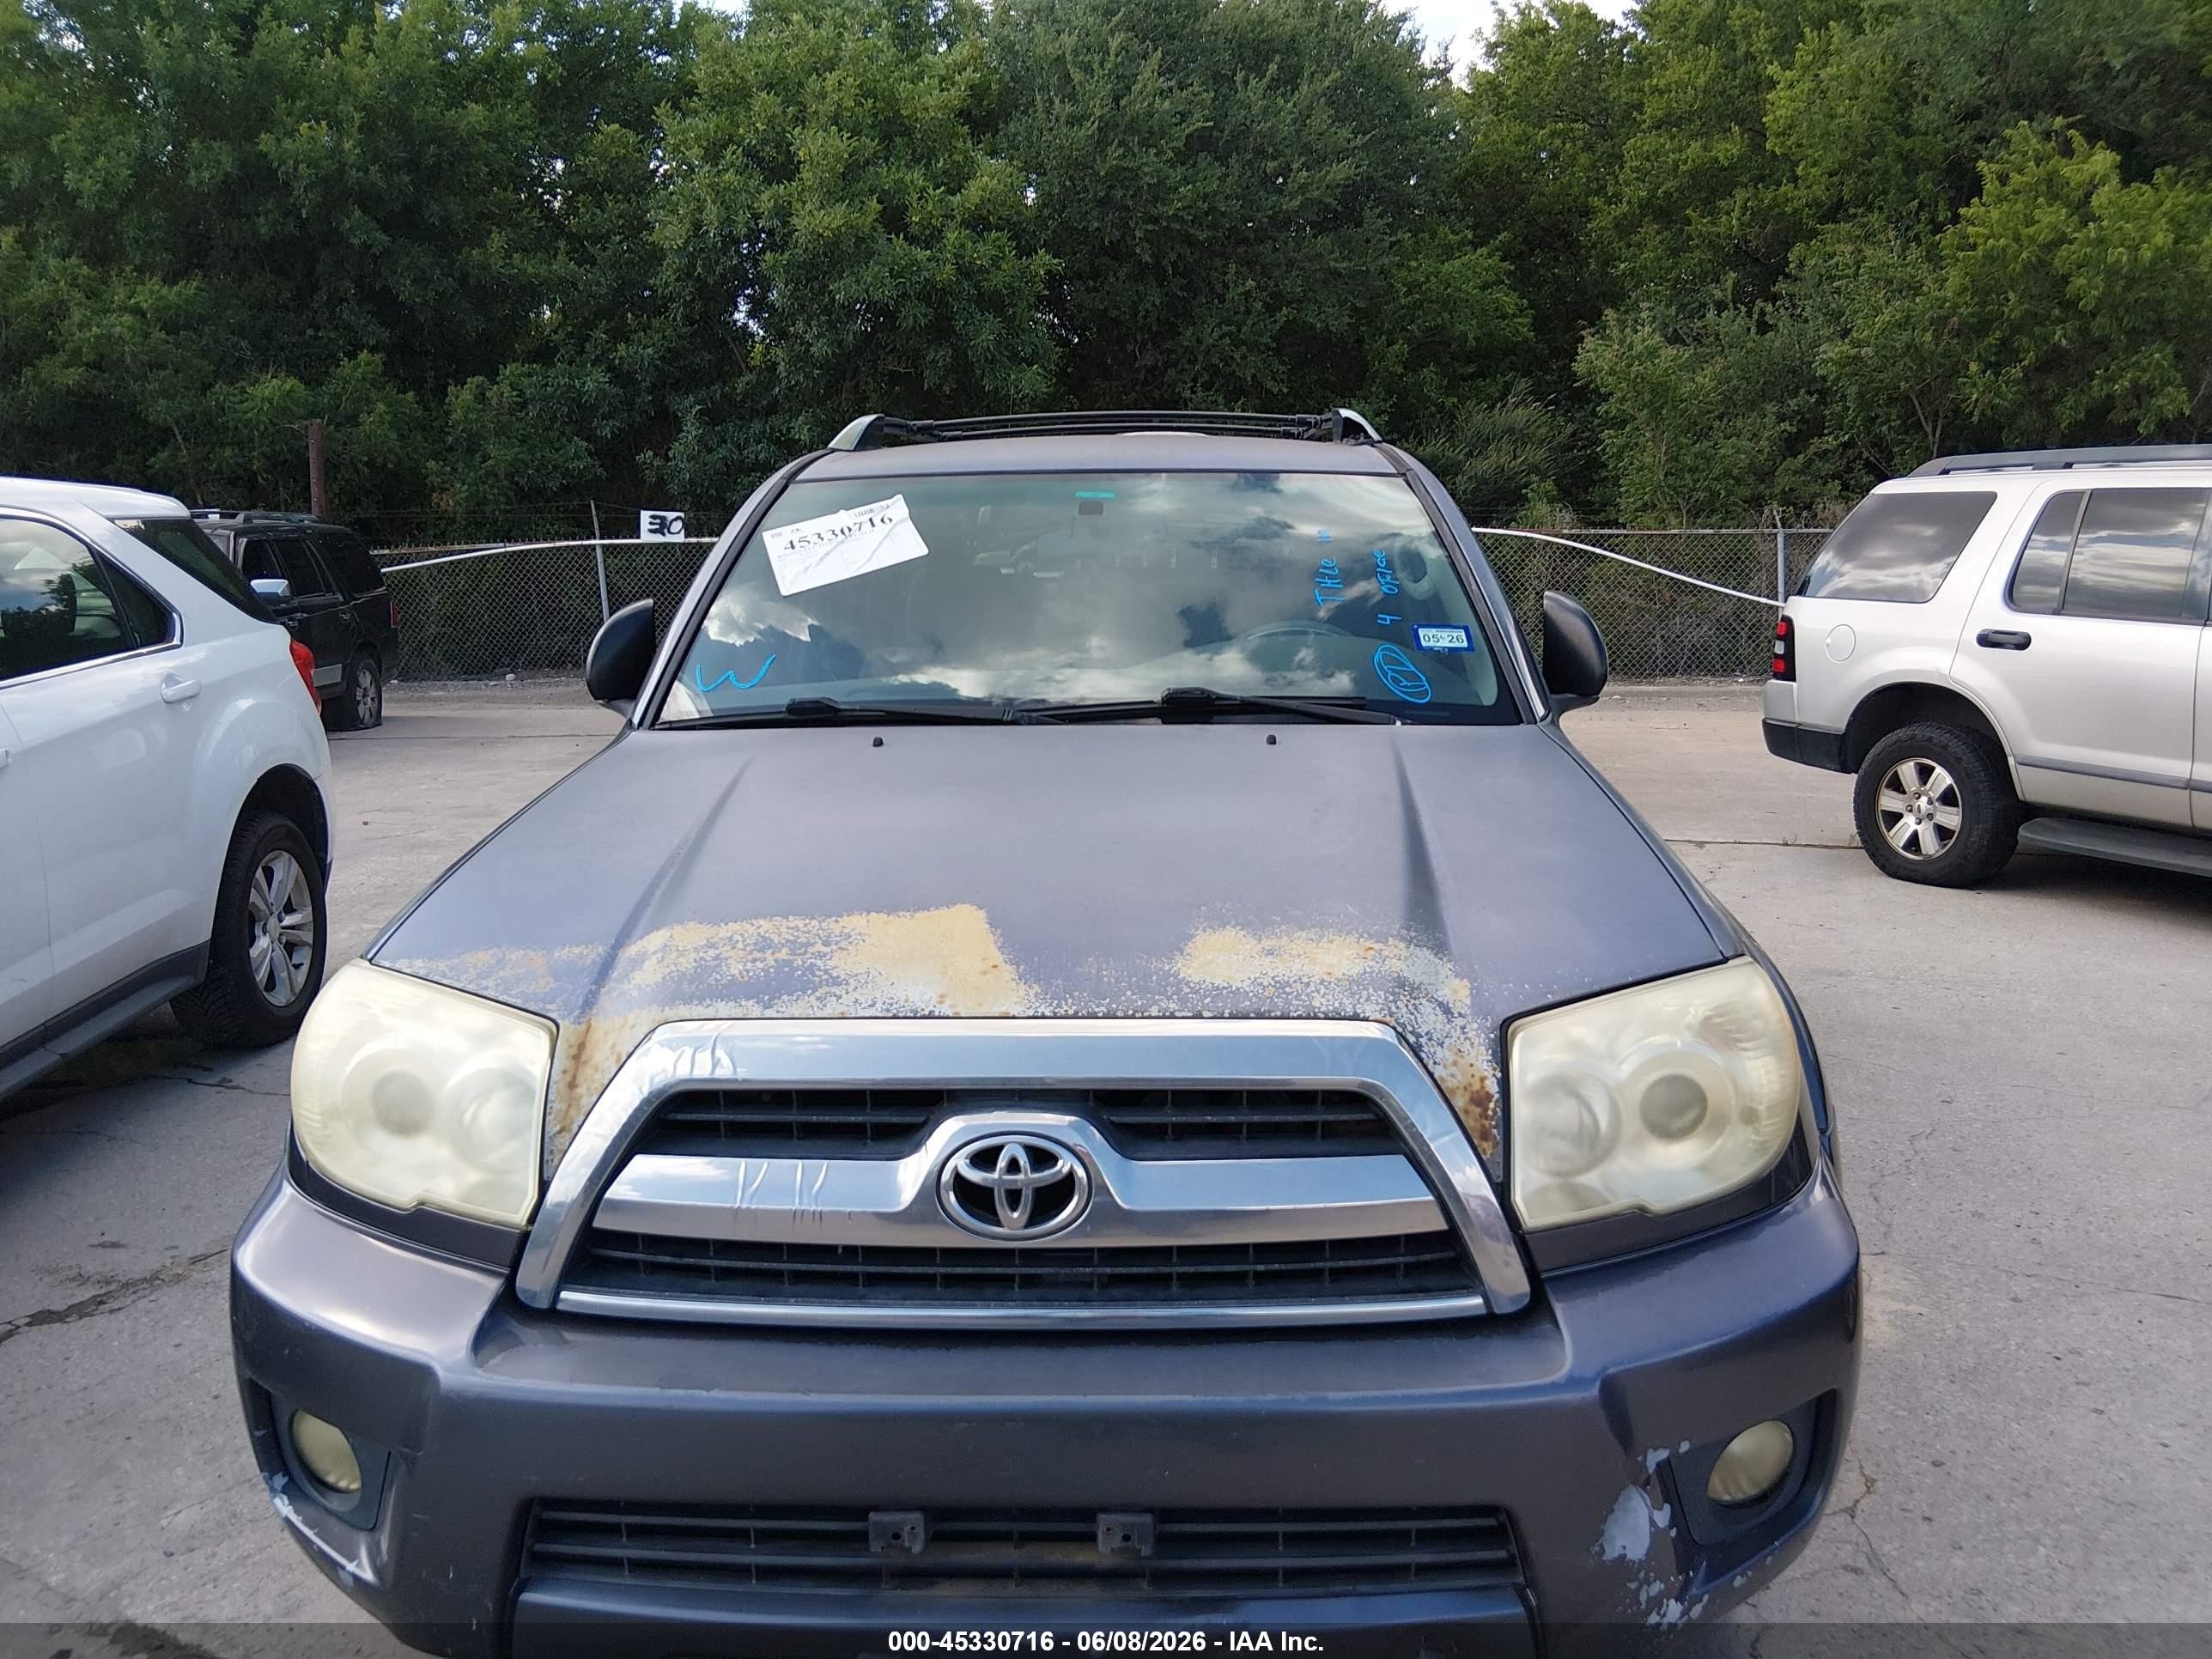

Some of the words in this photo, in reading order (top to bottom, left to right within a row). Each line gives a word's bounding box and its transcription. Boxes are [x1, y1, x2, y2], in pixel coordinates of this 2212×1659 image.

[784, 514, 893, 551] 45330716
[1422, 634, 1440, 643] 05
[1447, 635, 1464, 644] 26
